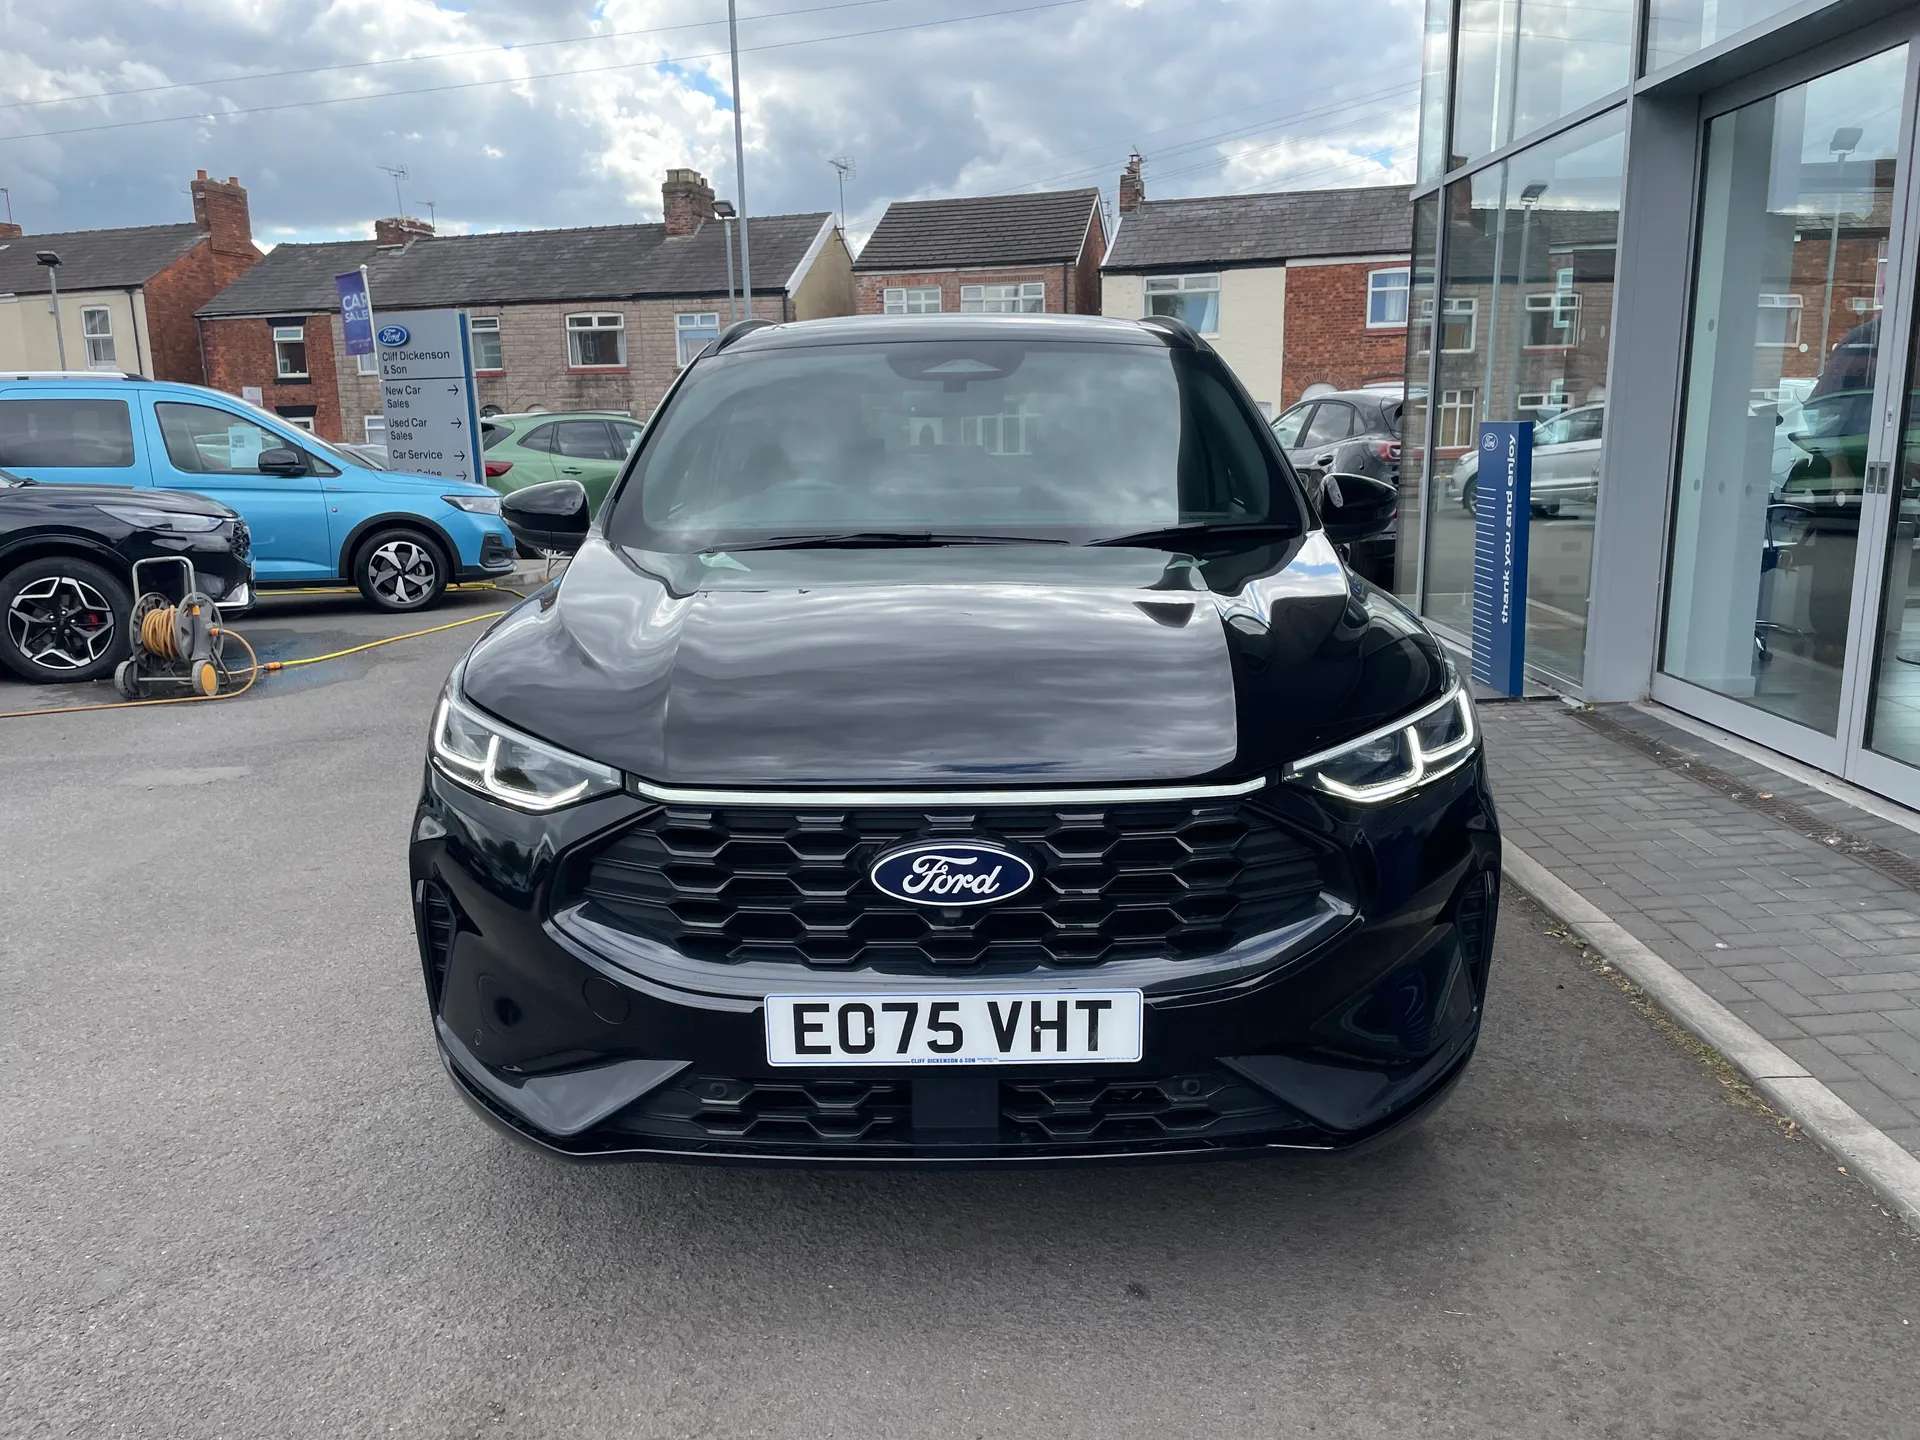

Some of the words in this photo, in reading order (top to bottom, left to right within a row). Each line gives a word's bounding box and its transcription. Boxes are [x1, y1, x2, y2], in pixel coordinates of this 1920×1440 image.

[382, 328, 401, 342] Ford
[382, 351, 398, 361] Cliff
[400, 350, 450, 361] Dickenson
[384, 365, 390, 375] &
[391, 364, 408, 375] Son
[385, 386, 404, 396] New
[405, 385, 421, 395] Car
[387, 399, 410, 409] Sales
[389, 418, 410, 428] Used
[411, 418, 427, 428] Car
[391, 430, 413, 441] Sales
[392, 449, 406, 459] Car
[408, 449, 443, 460] Service
[1507, 434, 1516, 488] enjoy
[1505, 490, 1513, 528] and
[1504, 532, 1512, 567] you
[1502, 569, 1510, 625] thank
[902, 855, 1002, 894] Ford
[792, 1001, 964, 1055] EO75
[986, 1000, 1112, 1053] VHT
